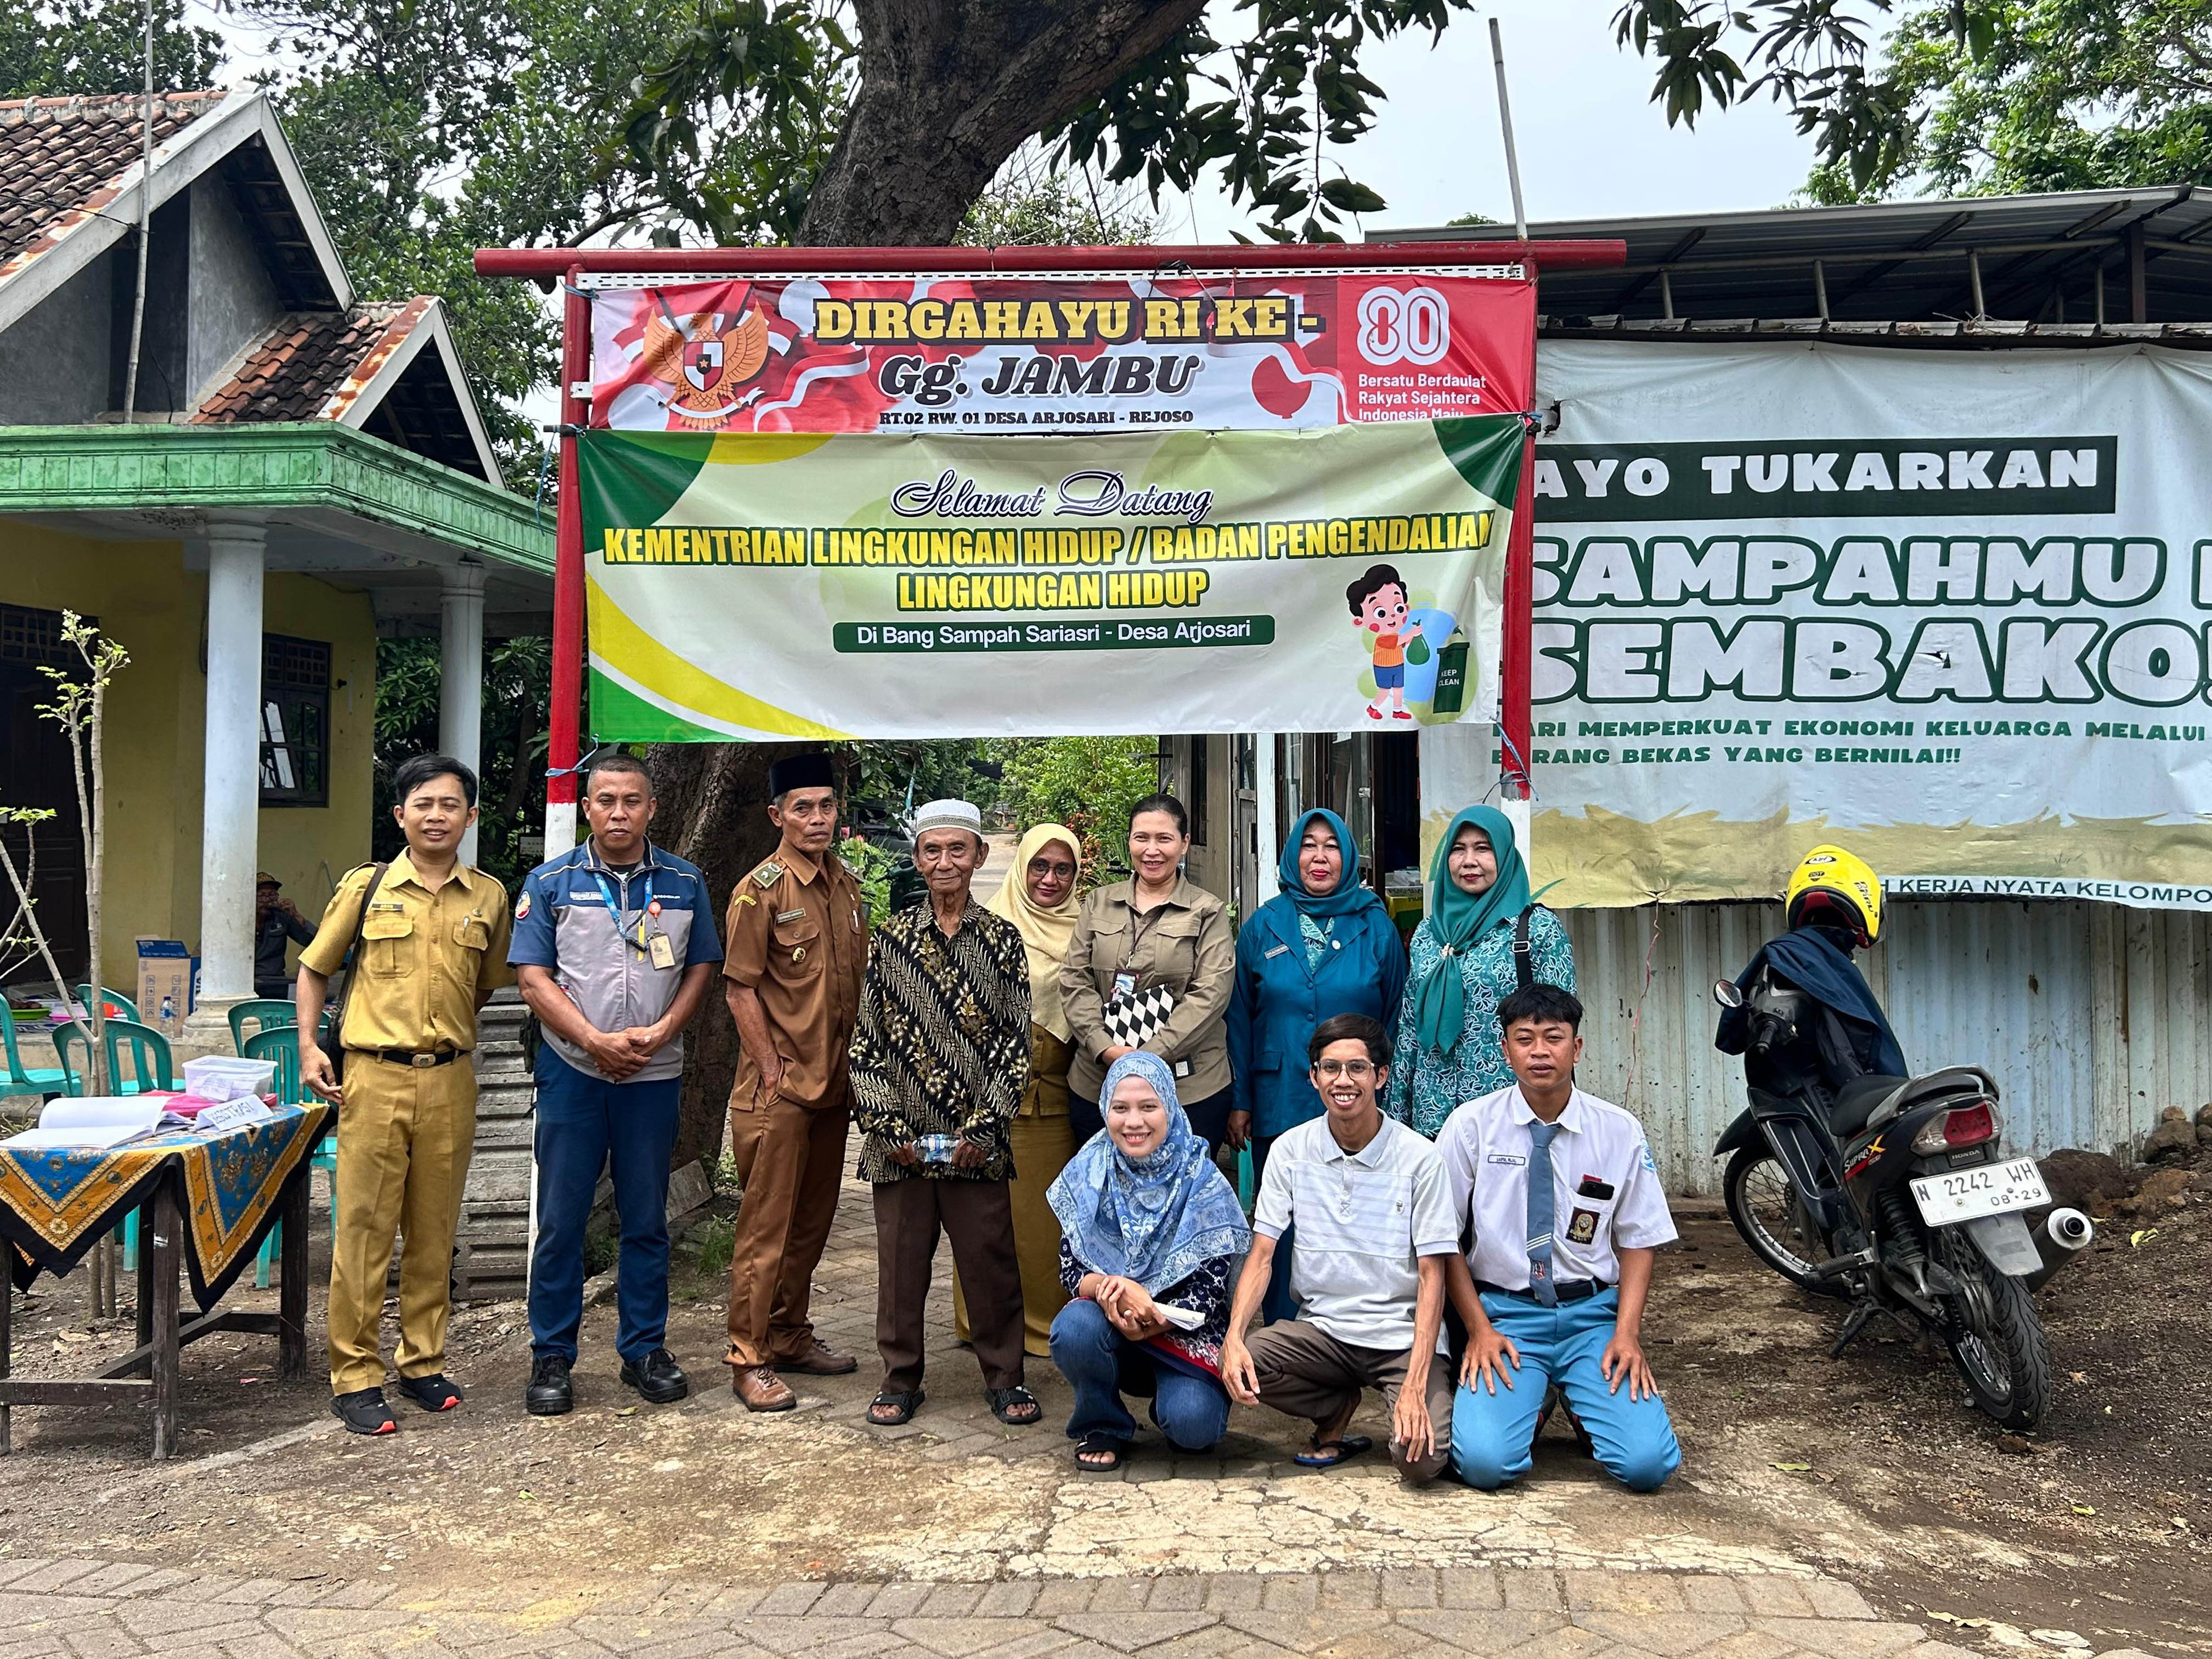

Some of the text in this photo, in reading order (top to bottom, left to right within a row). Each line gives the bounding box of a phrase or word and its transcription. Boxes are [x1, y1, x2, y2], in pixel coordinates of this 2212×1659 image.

[814, 298, 1131, 341] DIRGAHAYU
[1144, 298, 1200, 339] RI
[1214, 298, 1288, 337] KE
[1357, 286, 1450, 366] 80
[879, 355, 1200, 405] Gg. JAMBU
[1359, 374, 1486, 388] Bersatu Berdaulat
[1359, 391, 1480, 407] Rakyat Sejahtera
[879, 413, 924, 425] RT.02
[928, 413, 958, 424] RW.
[962, 413, 980, 424] 01
[985, 412, 1028, 424] DESA
[1031, 411, 1115, 424] ARJOSARI
[1129, 411, 1194, 423] REJOSO
[1359, 408, 1427, 421] Indonesia
[1534, 448, 2097, 498] AYO TUKARKAN
[891, 469, 1214, 524] Selamat Datang
[603, 526, 807, 565] KEMENTRIAN
[812, 527, 1019, 567] LINGKUNGAN
[1023, 527, 1124, 566] HIDUP
[1151, 523, 1261, 563] BADAN
[1532, 535, 2167, 608] SAMPAHMU
[896, 568, 1210, 611] LINGKUNGAN HIDUP
[858, 627, 877, 644] Di
[883, 627, 934, 648] Bang
[939, 625, 1021, 648] Sampah
[1025, 624, 1099, 642] Sariasri
[1118, 623, 1168, 641] Desa
[1173, 619, 1251, 644] Arjosari
[1438, 678, 1460, 687] CLEAN
[1577, 720, 1772, 737] MEMPERKUAT
[1784, 720, 1914, 737] EKONOMI
[1926, 720, 2072, 737] KELUARGA
[2085, 721, 2205, 741] MELALUI
[1622, 747, 1711, 764] BEKAS
[1723, 747, 1803, 763] YANG
[1814, 747, 1961, 764] BERNILAI!!
[1899, 879, 1974, 893] KERJA
[1983, 880, 2067, 895] NYATA
[2075, 882, 2212, 904] KELOMPO
[1951, 1149, 1980, 1160] HONDA
[1916, 1163, 2035, 1201] N 2242 WH
